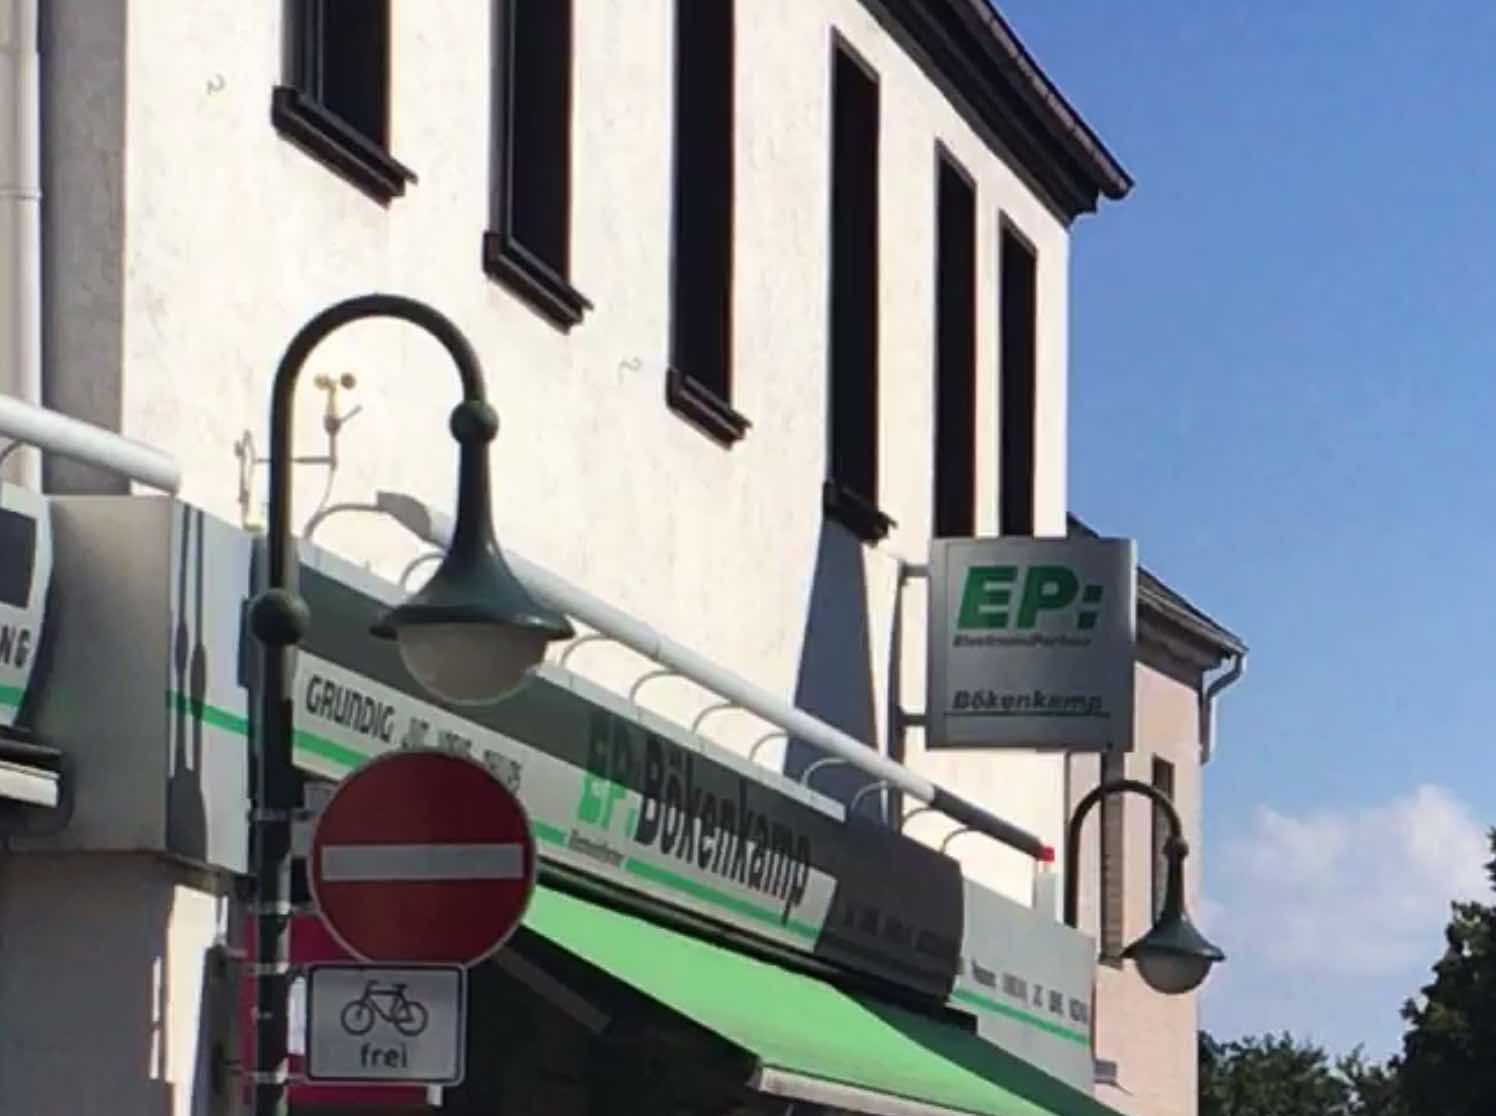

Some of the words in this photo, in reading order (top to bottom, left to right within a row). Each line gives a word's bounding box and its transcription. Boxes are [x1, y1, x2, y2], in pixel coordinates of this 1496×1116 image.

[957, 565, 1104, 630] EP:
[305, 673, 396, 743] GRUNDIG
[952, 689, 1104, 714] Bökenkamp
[360, 1042, 408, 1068] frei
